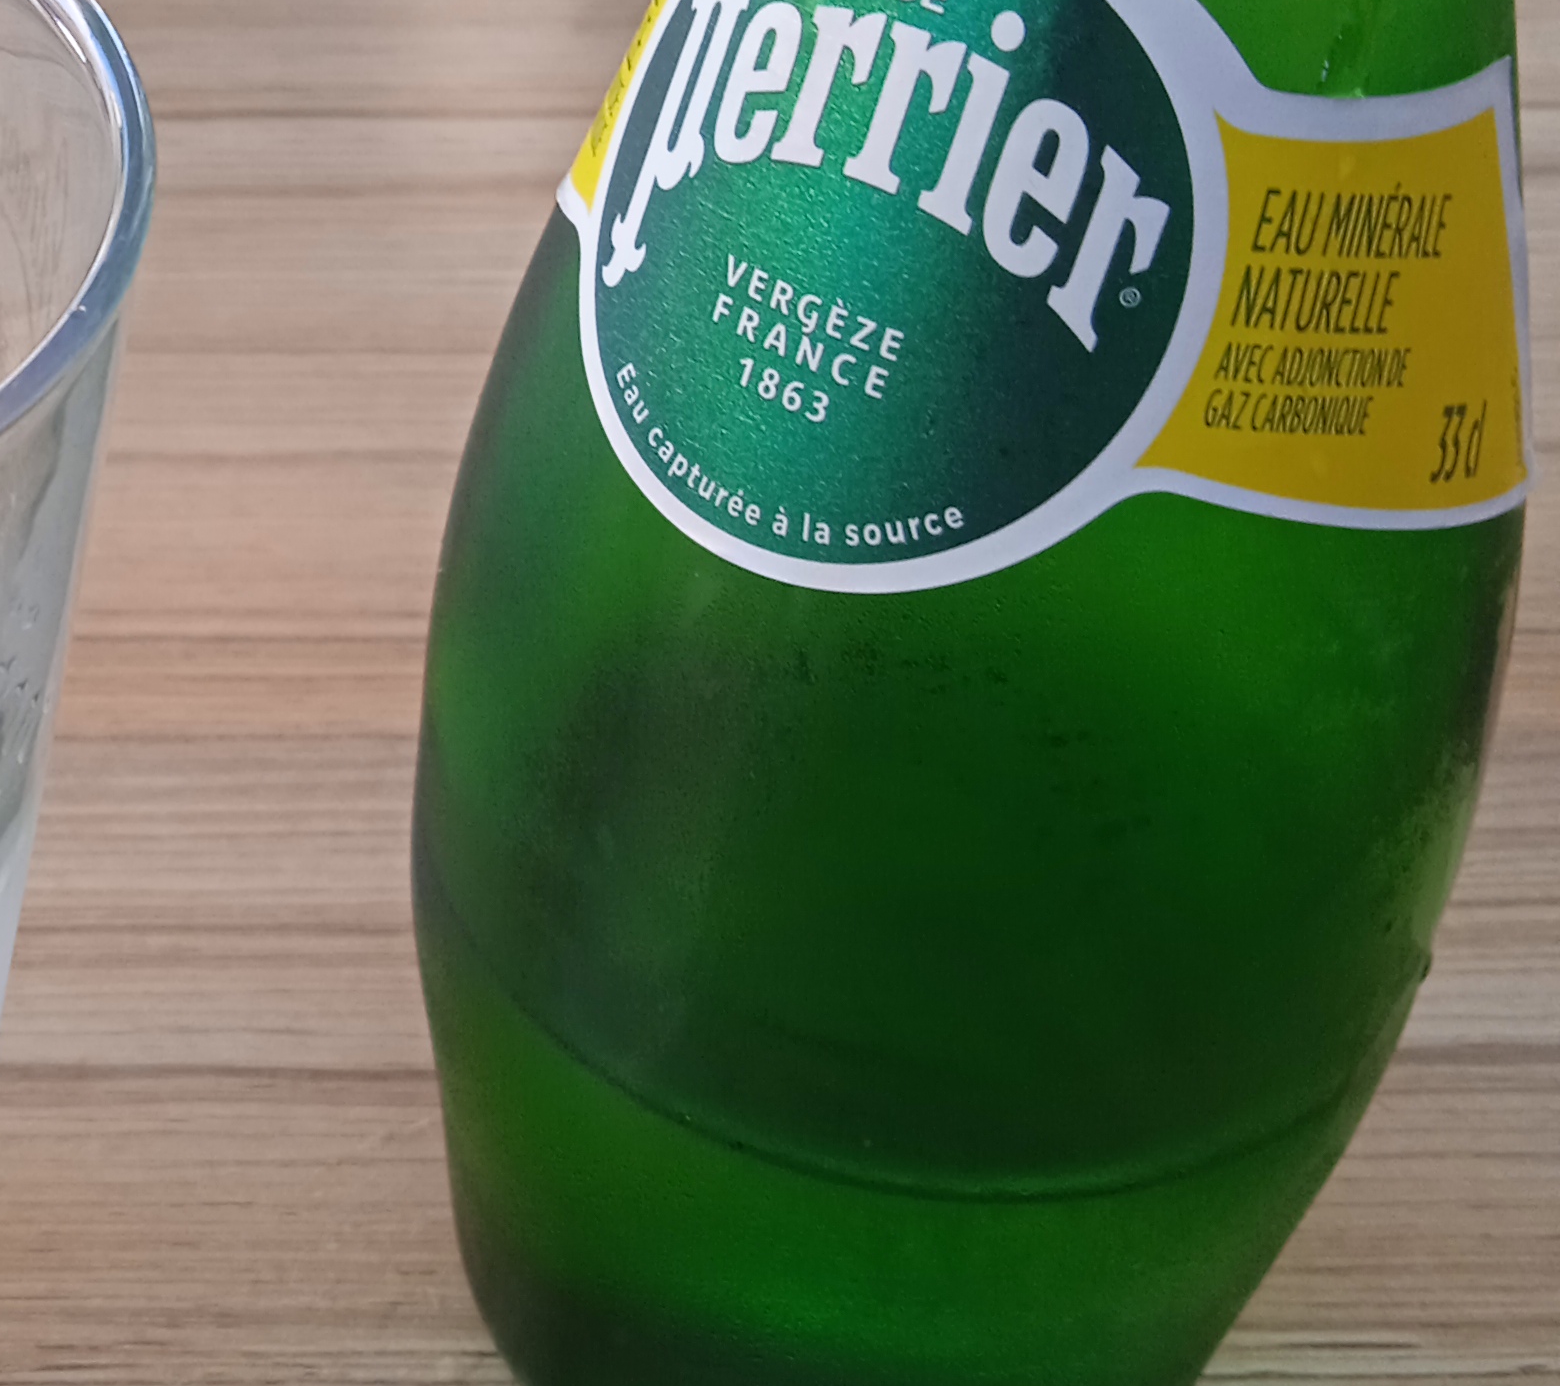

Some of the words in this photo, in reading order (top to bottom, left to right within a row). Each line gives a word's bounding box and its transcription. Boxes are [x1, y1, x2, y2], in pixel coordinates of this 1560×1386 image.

[1251, 186, 1325, 256] EAU
[1322, 181, 1453, 259] MINÉRALE
[725, 254, 905, 363] VERGÈZE
[1231, 264, 1401, 335] NATURELLE
[711, 293, 890, 400] FRANCE
[1214, 342, 1274, 385] AVEC
[1271, 345, 1389, 388] ADJONCTION
[1386, 348, 1412, 388] DE
[738, 357, 831, 424] 1863
[1203, 388, 1251, 431] GAZ
[1250, 393, 1374, 436] CARBONIQUE
[615, 361, 649, 424] Eau
[647, 423, 762, 526] capturée
[771, 506, 789, 537] à
[801, 512, 832, 546] la
[844, 504, 966, 548] source
